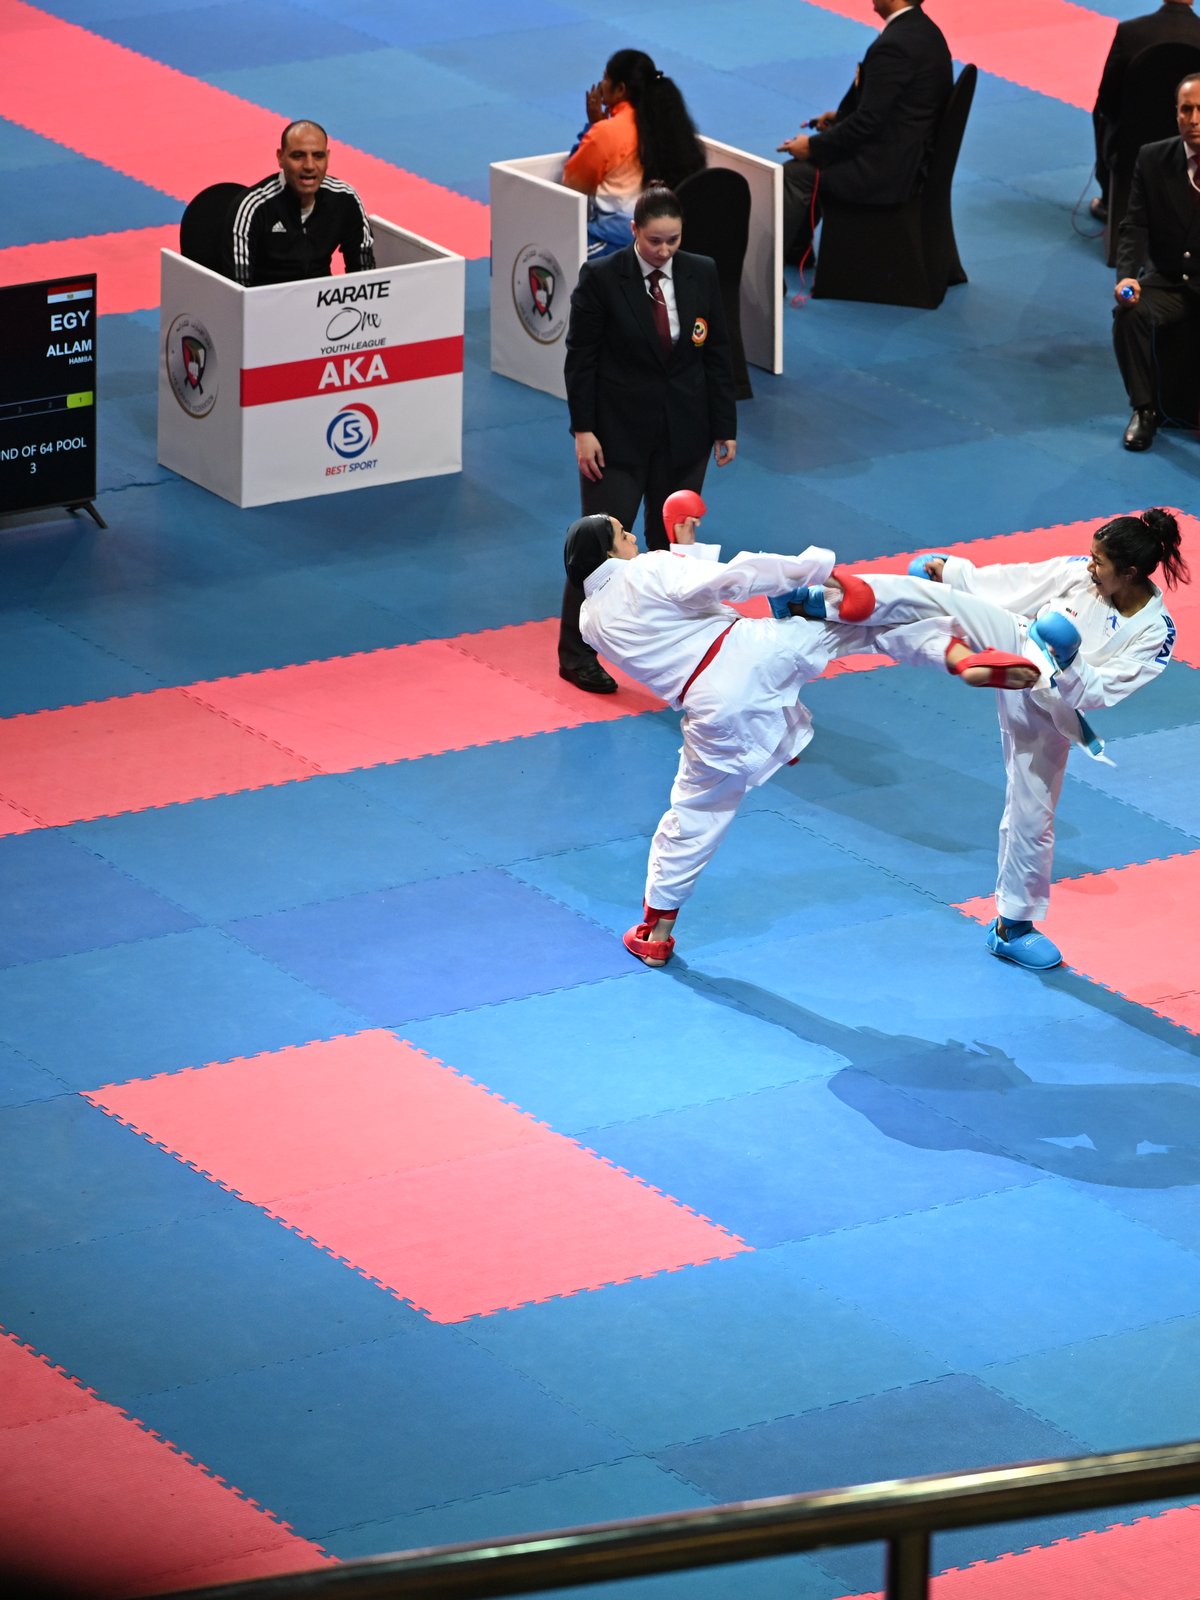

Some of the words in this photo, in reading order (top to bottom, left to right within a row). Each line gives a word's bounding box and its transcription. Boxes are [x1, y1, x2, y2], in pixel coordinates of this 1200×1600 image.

[316, 280, 391, 308] KARATE
[50, 309, 91, 332] EGY
[325, 306, 381, 342] One
[46, 339, 92, 357] ALLAM
[320, 344, 350, 355] YOUTH
[351, 337, 386, 351] LEAGUE
[318, 352, 389, 390] AKA
[21, 444, 37, 458] OF
[39, 441, 53, 455] 64
[56, 436, 87, 452] POOL
[30, 462, 37, 474] 3
[325, 464, 347, 476] BEST
[348, 459, 378, 472] SPORT
[1154, 614, 1176, 665] SMAI
